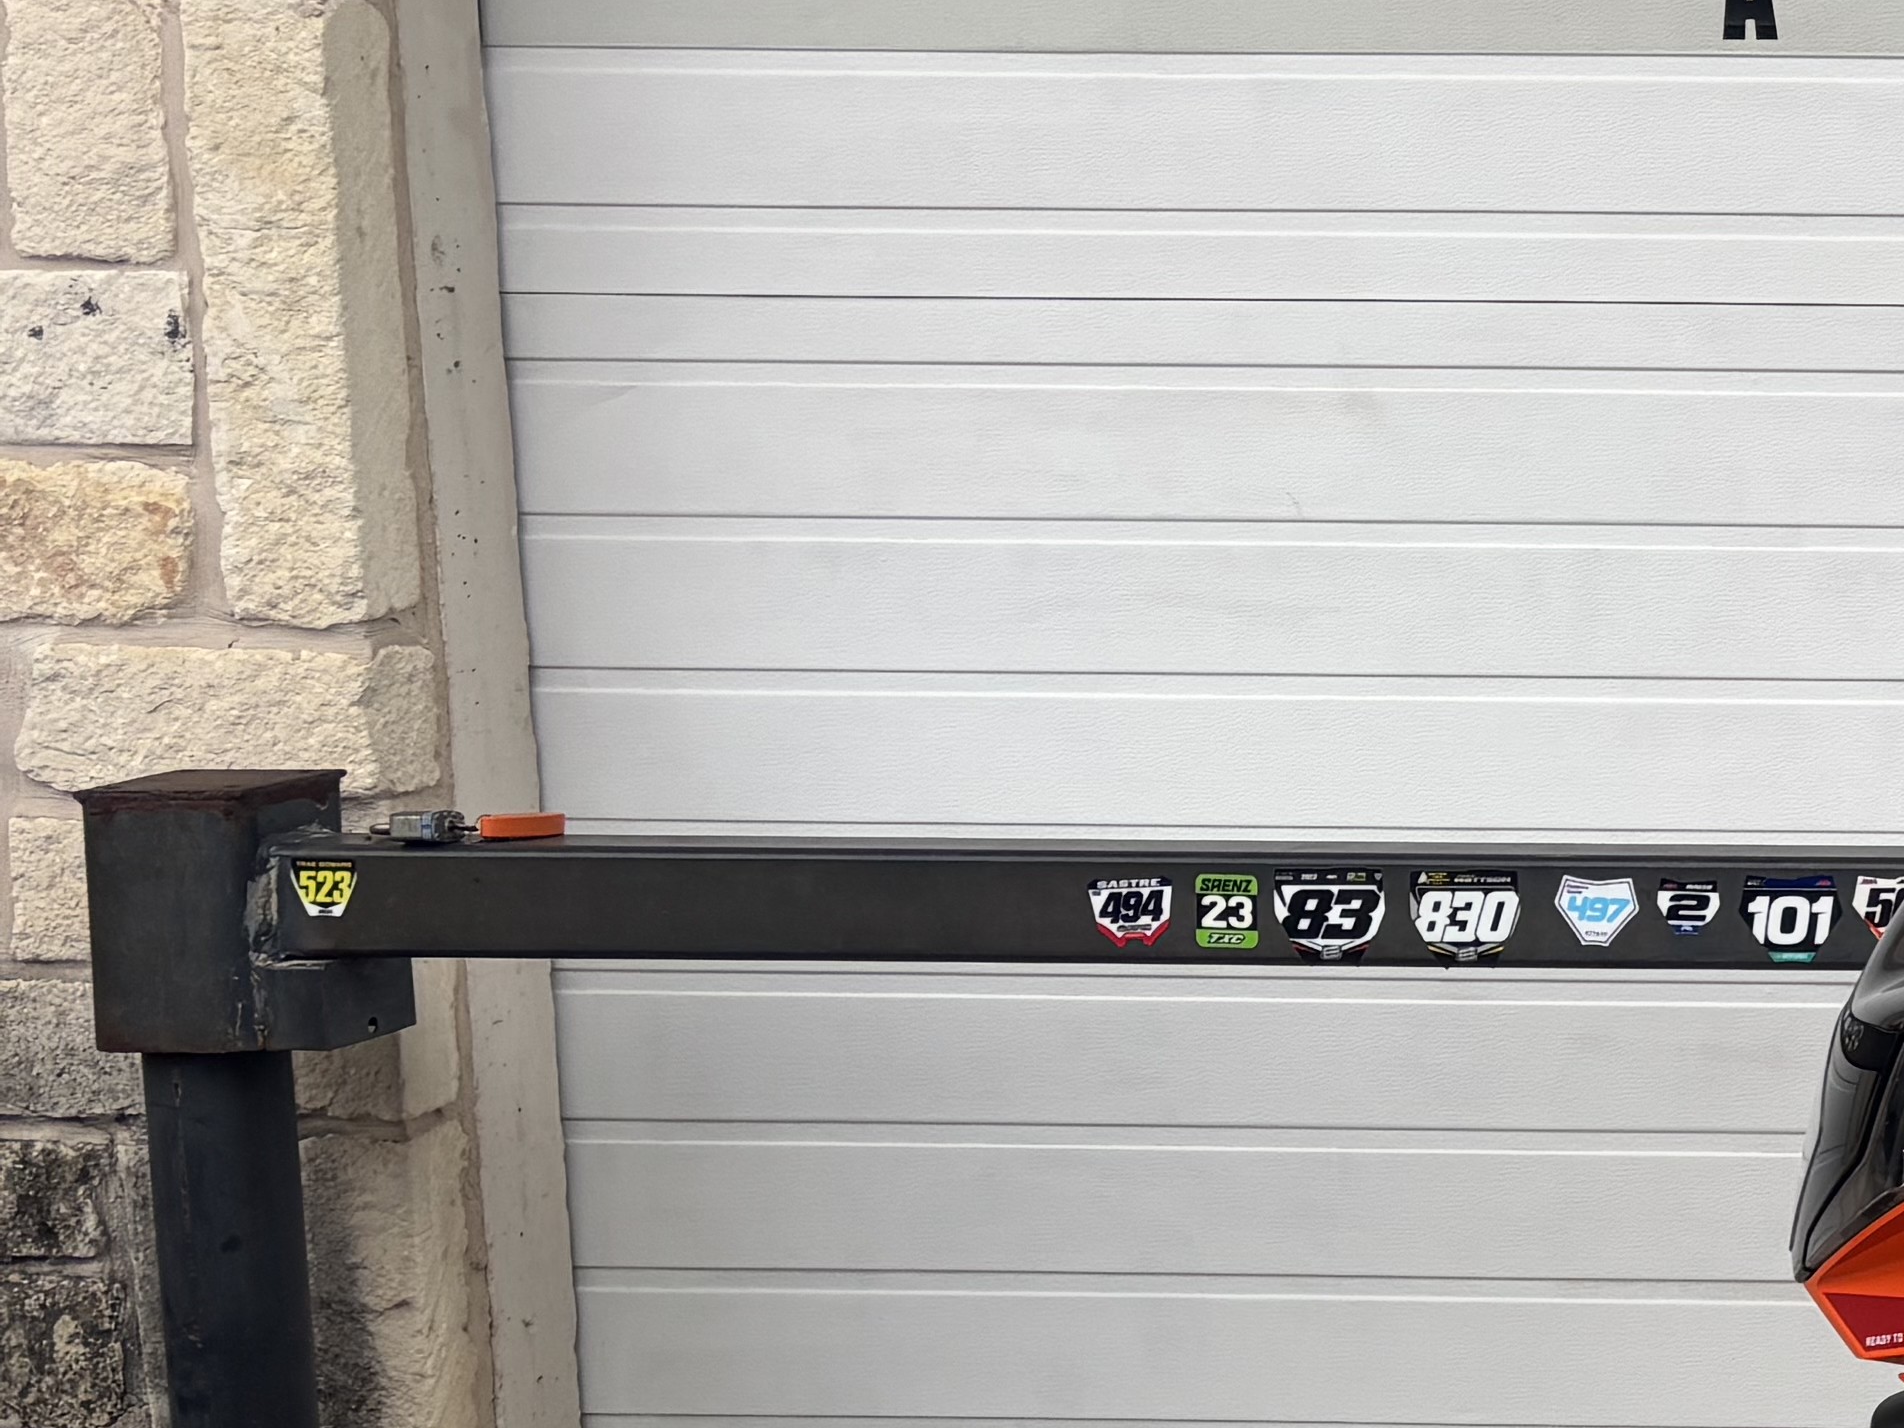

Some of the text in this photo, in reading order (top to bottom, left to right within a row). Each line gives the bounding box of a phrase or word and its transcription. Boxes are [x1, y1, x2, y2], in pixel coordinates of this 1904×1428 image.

[299, 871, 352, 903] 523
[1097, 878, 1161, 888] SASTRE
[1200, 878, 1252, 892] SAENZ
[1099, 884, 1164, 924] 494
[1201, 895, 1253, 929] 23
[1282, 889, 1380, 940] 83
[1415, 891, 1519, 942] 830
[1567, 896, 1630, 923] 497
[1665, 893, 1711, 922] 2
[1748, 896, 1834, 945] 101
